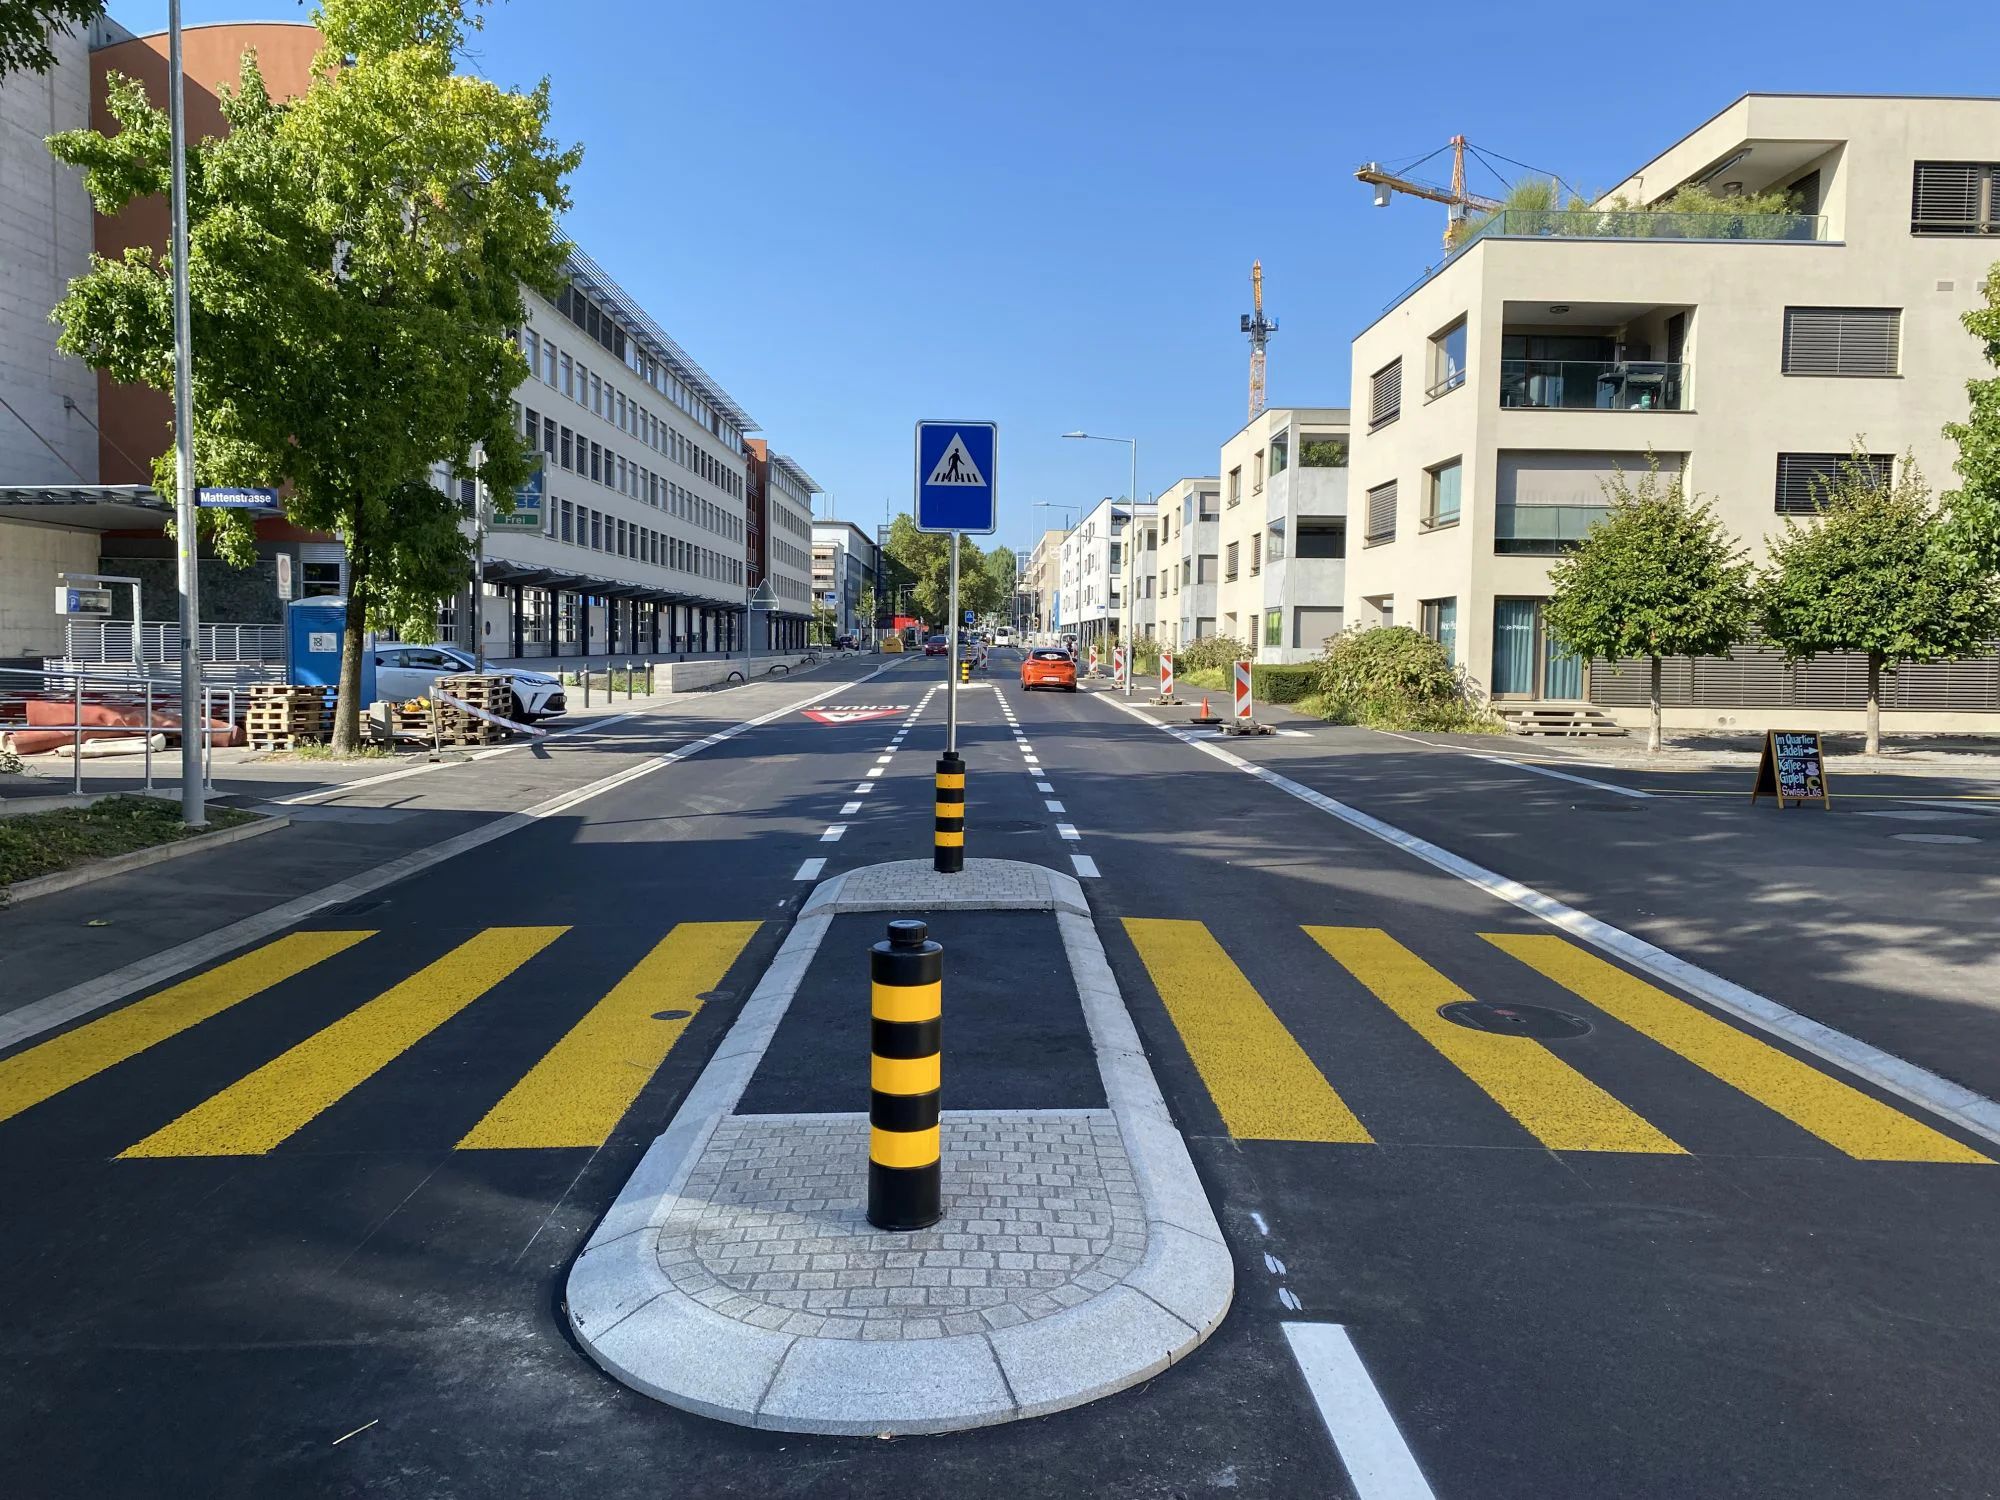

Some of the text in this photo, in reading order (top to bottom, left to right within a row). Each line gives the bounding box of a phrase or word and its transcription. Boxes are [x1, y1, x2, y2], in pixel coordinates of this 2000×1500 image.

[200, 492, 272, 503] Mattenstrasse
[505, 515, 526, 524] Frei
[1775, 734, 1815, 745] Im Quartier
[1777, 745, 1803, 756] Lädeli
[1778, 758, 1801, 773] Kaffee
[1779, 772, 1805, 788] Gipfeli
